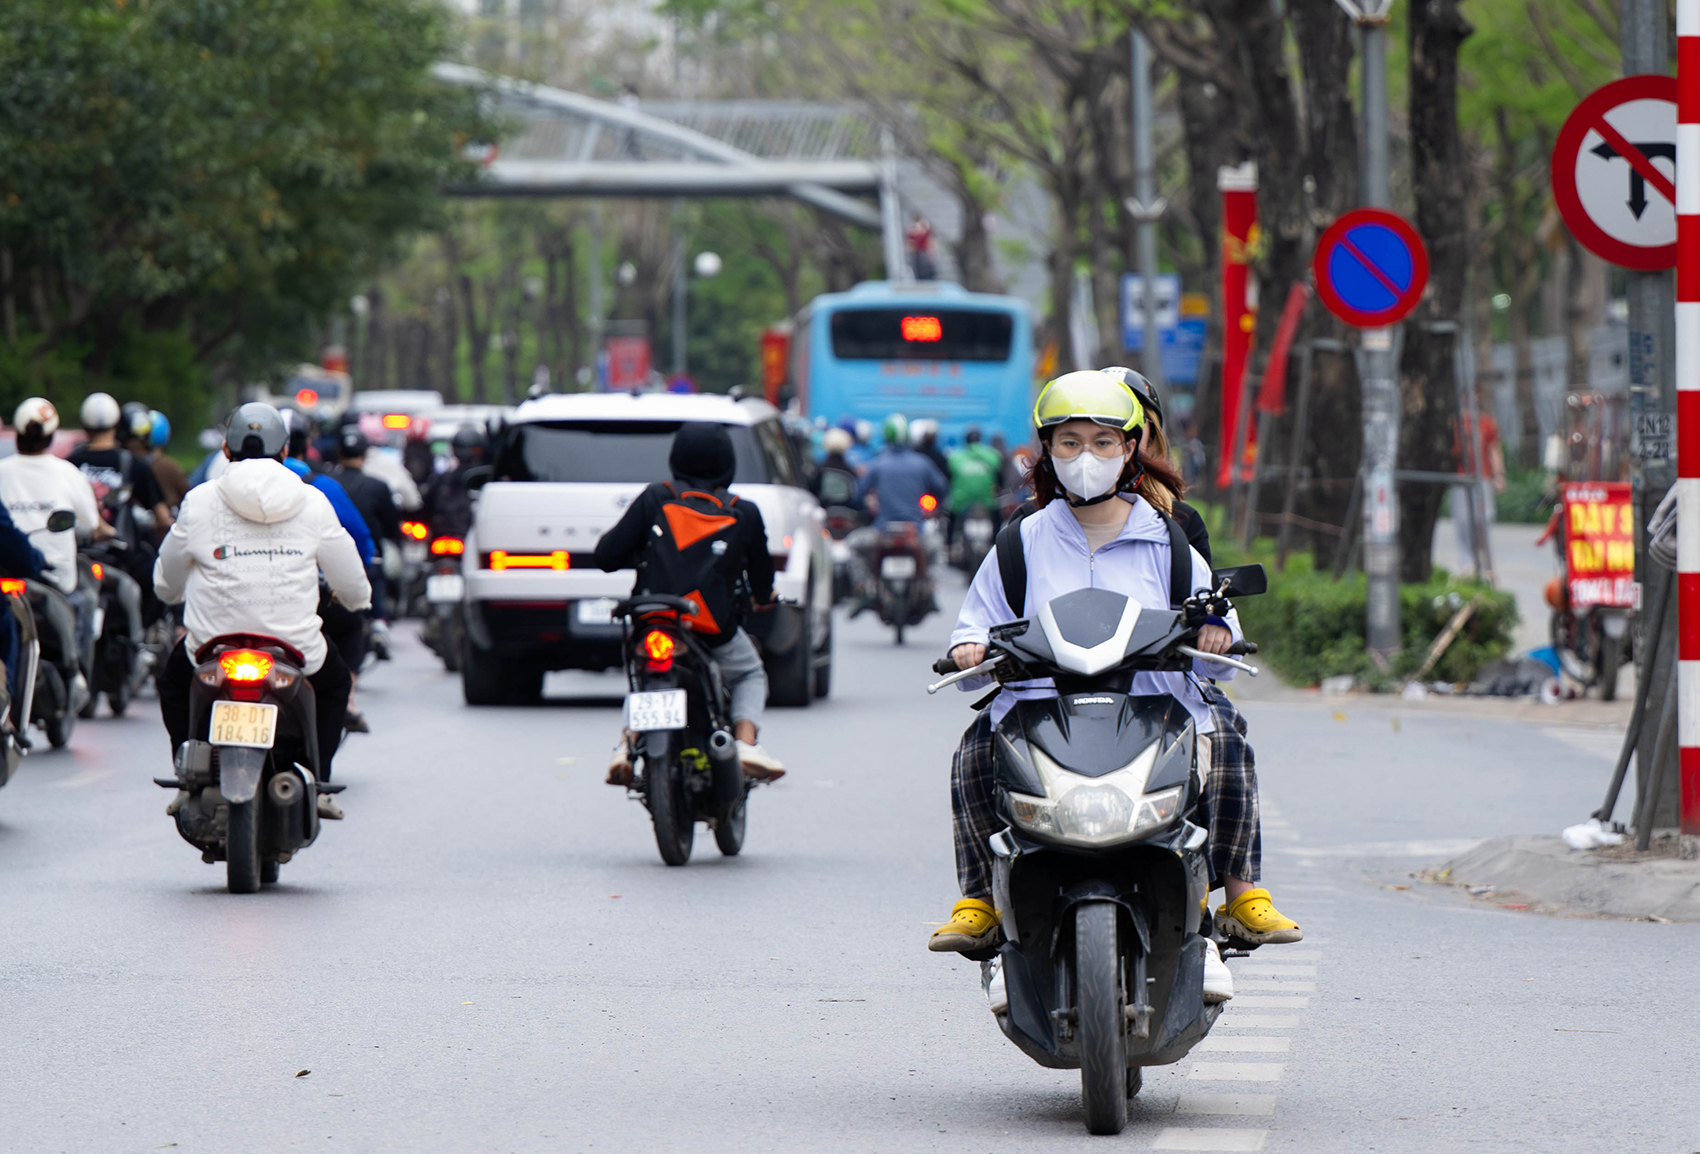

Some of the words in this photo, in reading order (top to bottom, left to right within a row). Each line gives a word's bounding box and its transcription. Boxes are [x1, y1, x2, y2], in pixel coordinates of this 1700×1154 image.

[213, 544, 303, 561] Champion
[1073, 696, 1115, 705] HONDA
[222, 704, 266, 724] 38-D1
[216, 724, 270, 744] 184.16
